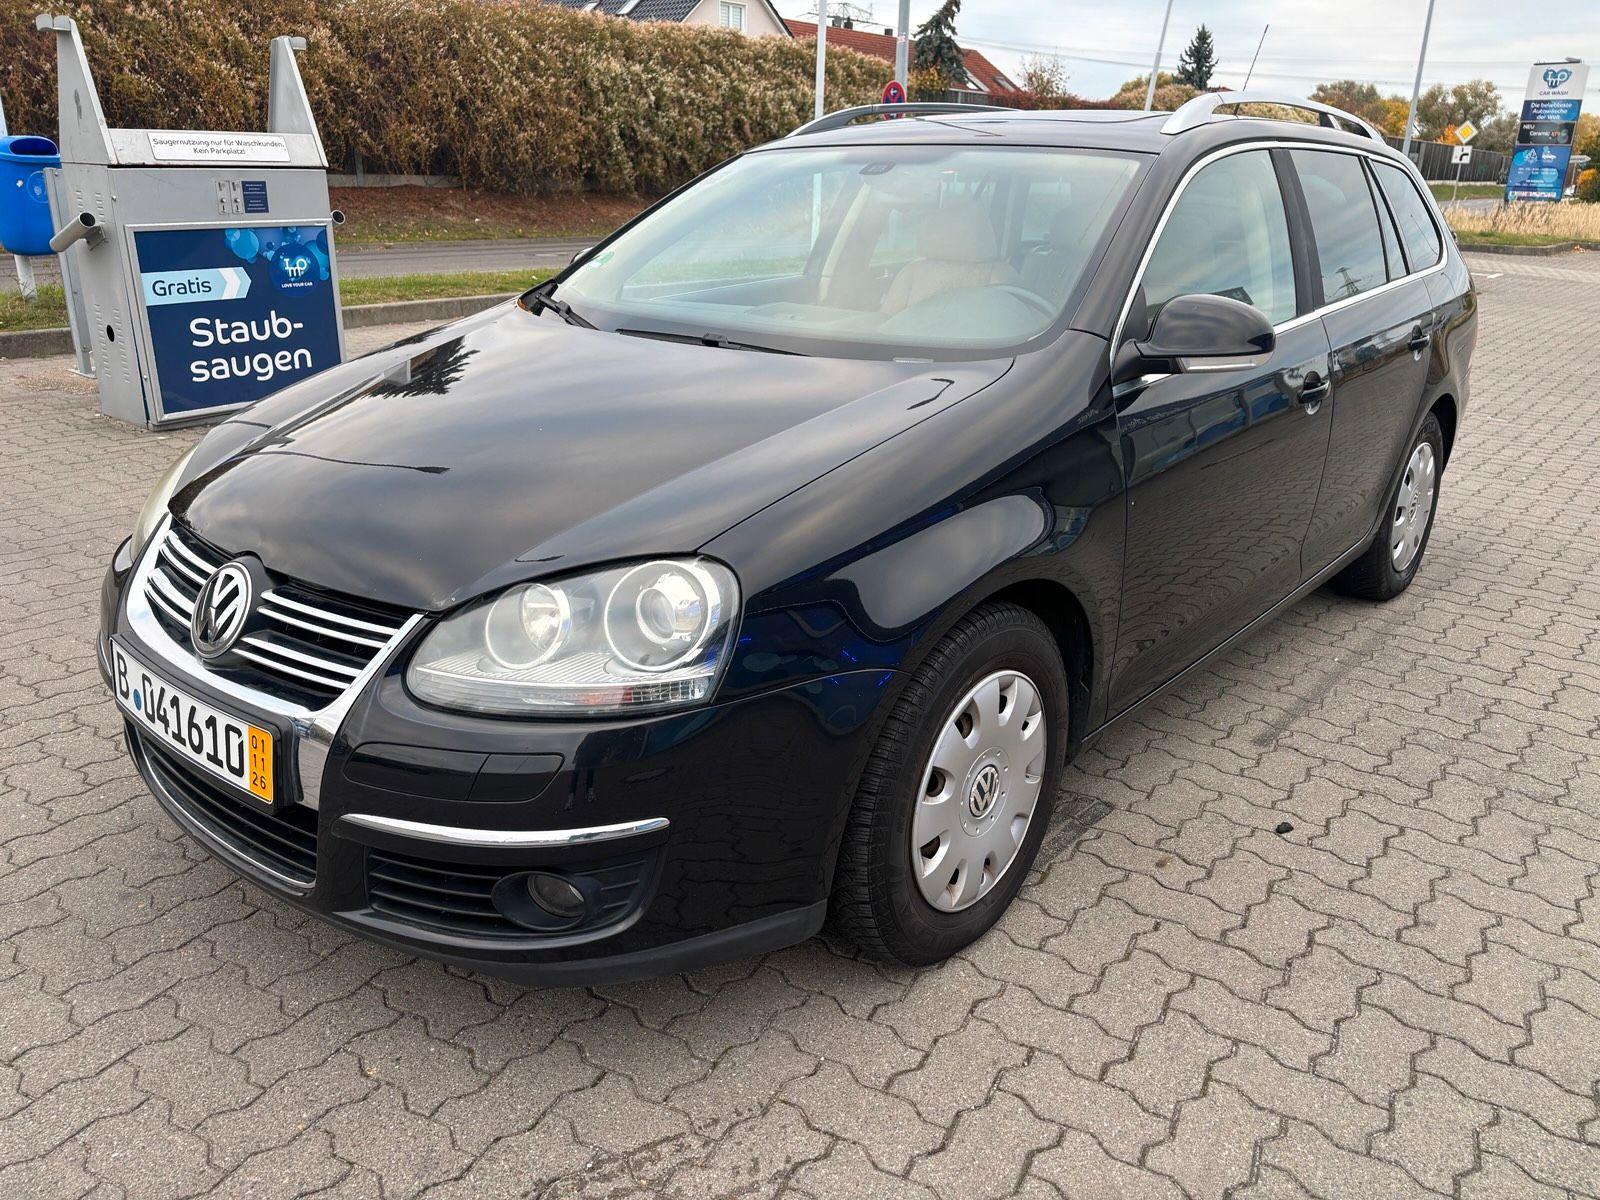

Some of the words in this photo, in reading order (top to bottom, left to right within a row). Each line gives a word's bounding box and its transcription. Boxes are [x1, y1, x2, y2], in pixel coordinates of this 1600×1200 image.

[153, 138, 209, 146] Saugernutzung
[152, 278, 212, 296] Gratis
[190, 310, 304, 347] Staub-
[190, 348, 312, 382] saugen
[117, 650, 130, 700] B
[252, 735, 265, 752] 01
[253, 754, 265, 772] 11
[252, 772, 266, 790] 26
